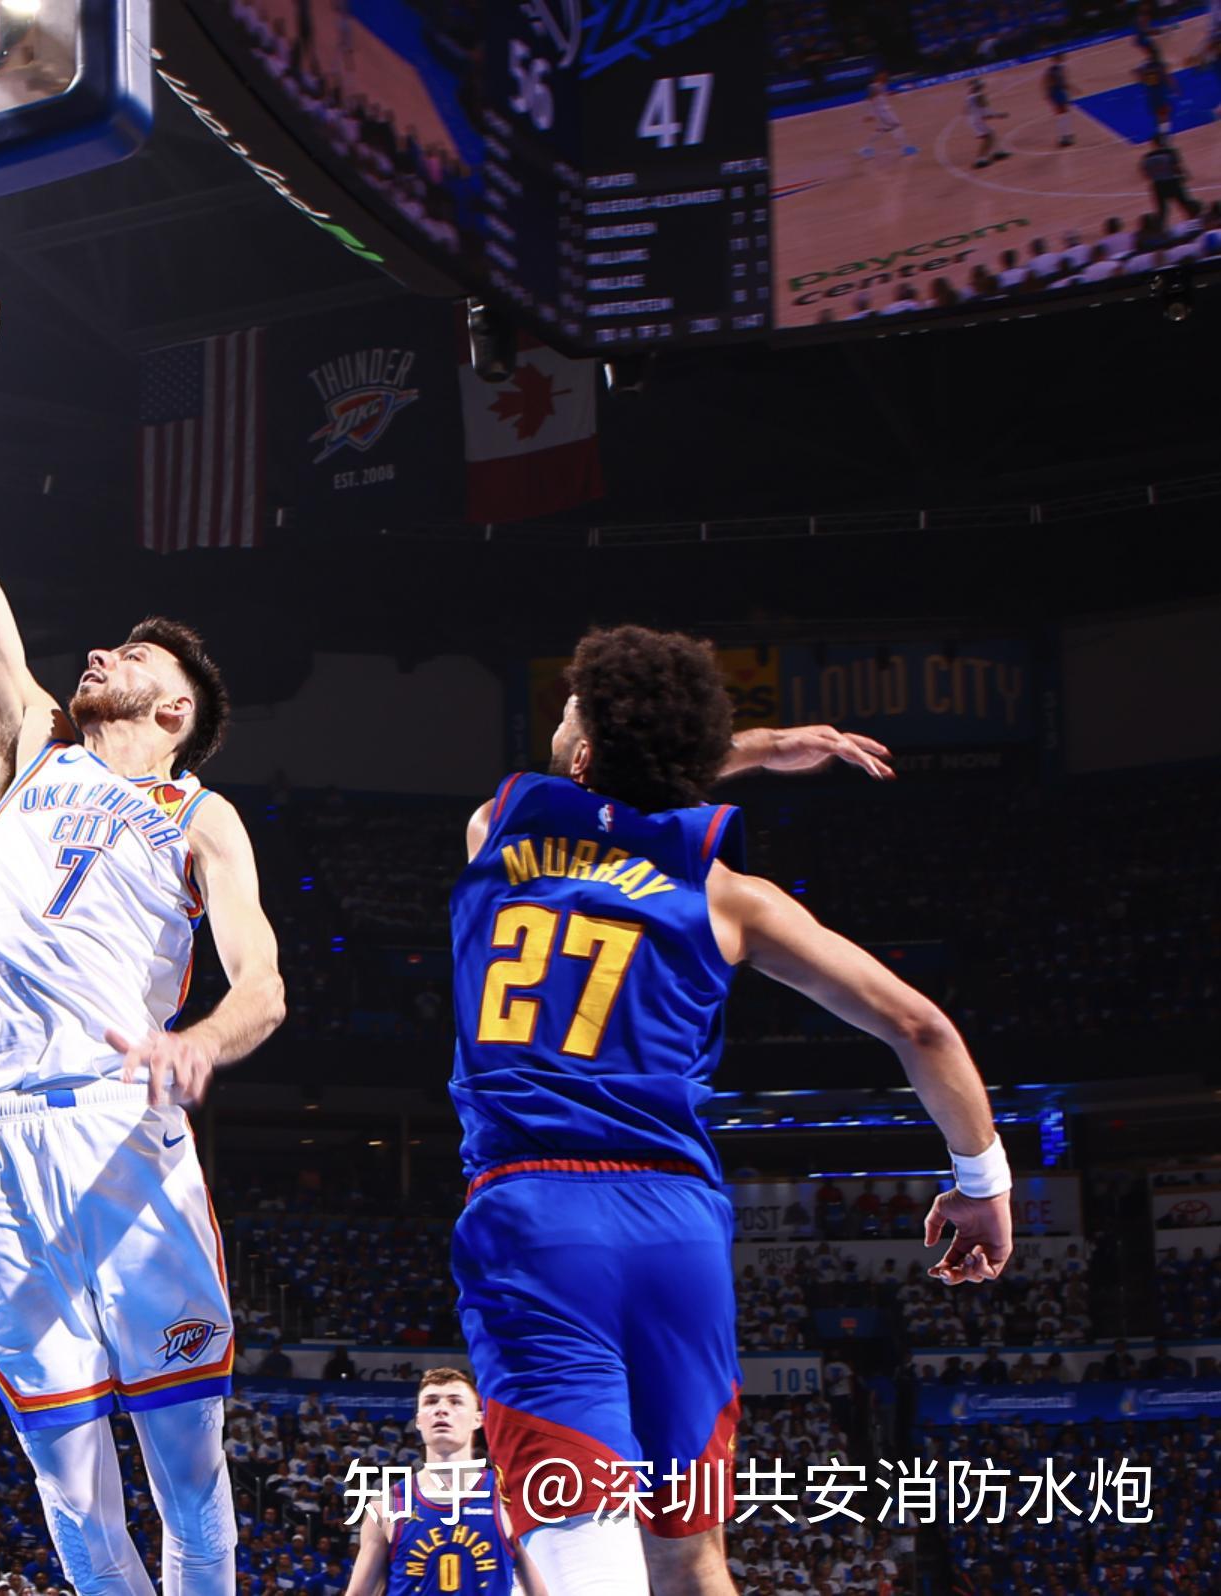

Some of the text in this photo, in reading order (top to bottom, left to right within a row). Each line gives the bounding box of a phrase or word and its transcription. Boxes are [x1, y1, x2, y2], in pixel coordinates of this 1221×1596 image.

[508, 38, 555, 132] 56
[636, 72, 715, 149] 47
[791, 218, 1030, 291] paycom
[792, 248, 976, 306] center
[307, 348, 416, 401] THUNDER
[333, 472, 361, 490] EST.
[789, 653, 1023, 727] LOUD CITY
[20, 783, 183, 851] OKLAHOMA
[50, 812, 129, 849] CITY
[43, 845, 102, 919] 7
[501, 837, 677, 900] MURRAY
[477, 902, 645, 1060] 27
[167, 1326, 204, 1358] OKC
[772, 1367, 818, 1393] 109
[405, 1524, 498, 1577] MILE HIGH
[439, 1553, 461, 1592] 0
